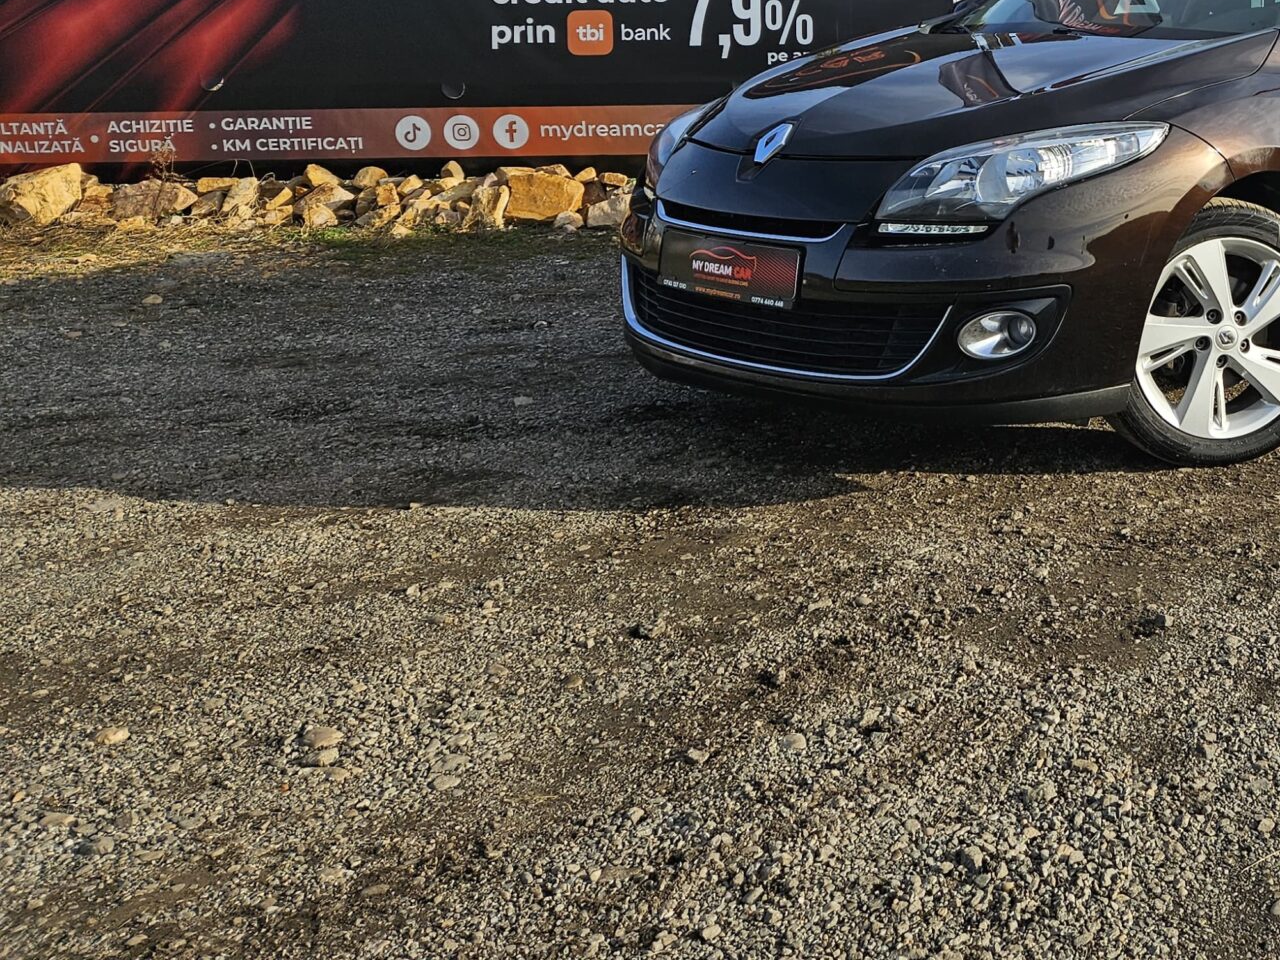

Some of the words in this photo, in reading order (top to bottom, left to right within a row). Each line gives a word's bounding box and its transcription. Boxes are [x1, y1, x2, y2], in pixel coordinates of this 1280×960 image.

[491, 18, 556, 50] prin
[576, 22, 605, 42] tbi
[620, 22, 671, 42] bank
[767, 51, 788, 65] pe
[107, 119, 194, 136] ACHIZIȚIE
[220, 116, 313, 135] GARANȚIE
[109, 136, 176, 153] SIGURĂ
[222, 139, 251, 152] KM
[255, 136, 364, 155] CERTIFICAȚI
[692, 259, 703, 272] MY
[704, 261, 732, 276] DREAM
